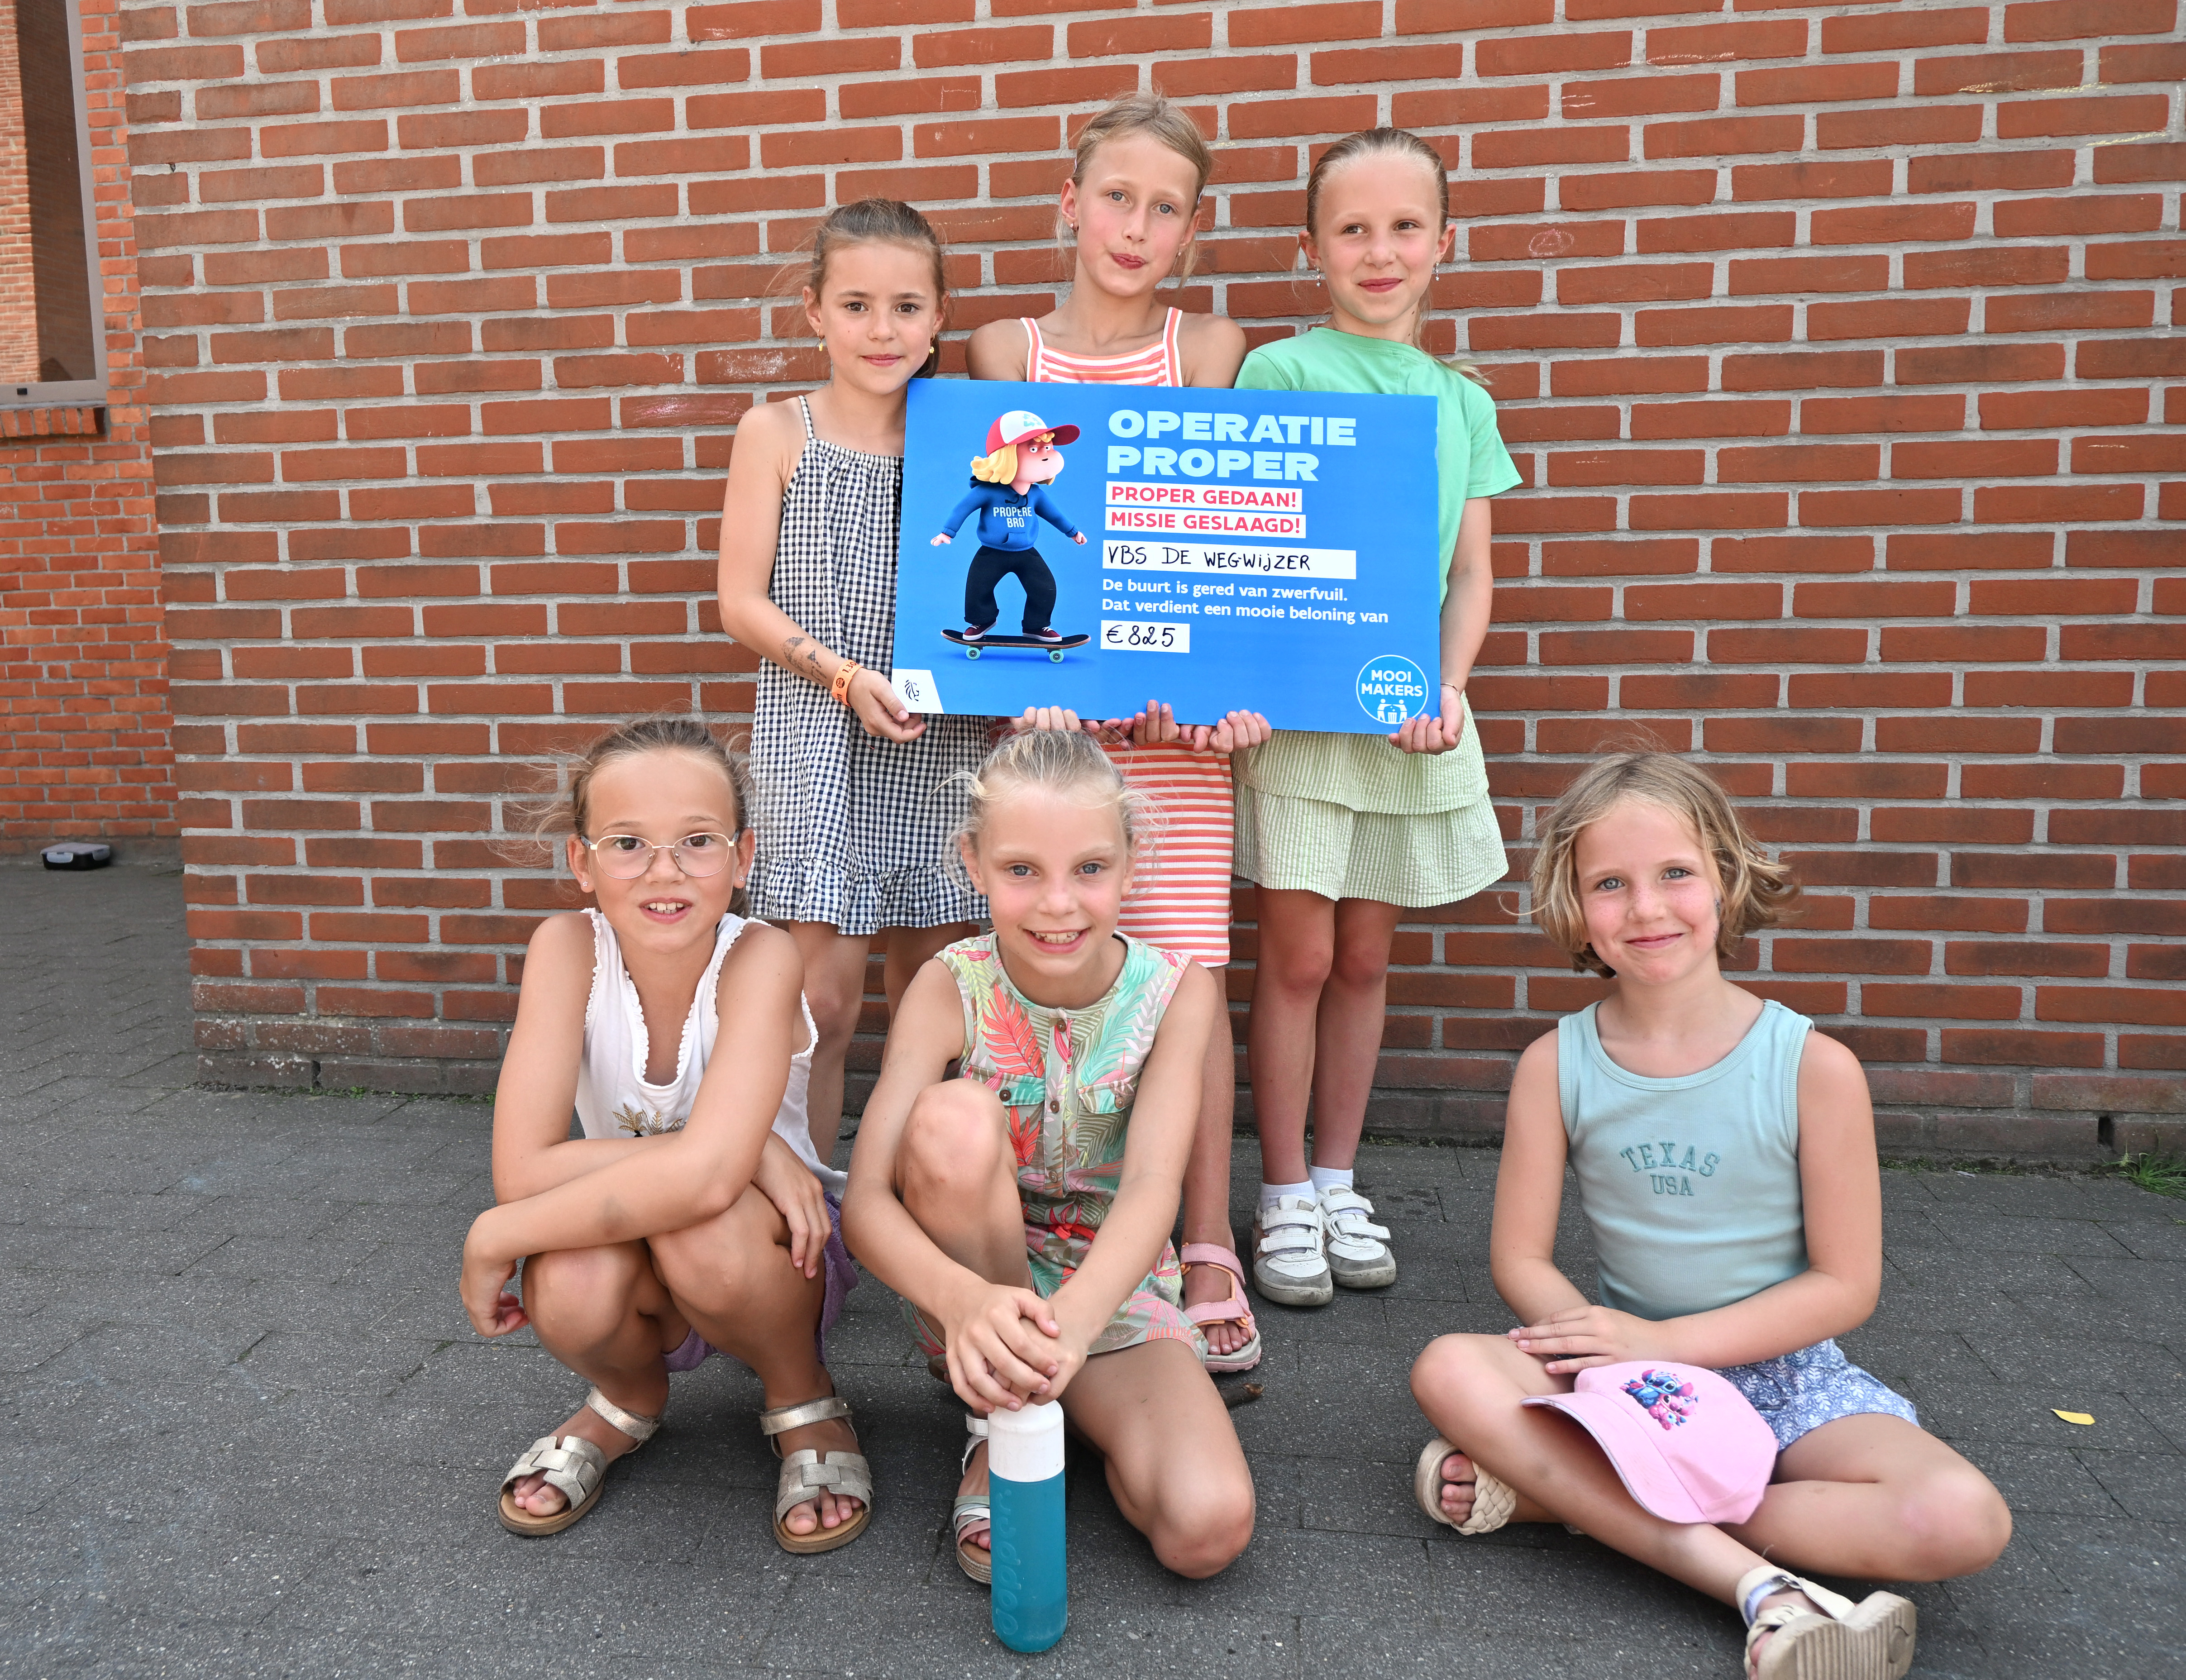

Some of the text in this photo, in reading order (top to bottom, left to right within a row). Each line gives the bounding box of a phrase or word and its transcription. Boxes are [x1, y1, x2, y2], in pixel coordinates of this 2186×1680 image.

[1108, 409, 1356, 446] OPERATIE
[1107, 445, 1319, 481] PROPER
[1112, 486, 1296, 507] PROPER GEDAAN!
[993, 507, 1032, 517] PROPERE
[1006, 517, 1025, 528] BRO
[1111, 512, 1300, 534] MISSIE GESLAAGD!
[1107, 545, 1147, 564] VBS
[1161, 547, 1191, 565] DE
[1103, 579, 1348, 601] De buurt is gered van zwerfvuil.
[1102, 598, 1388, 625] Dat verdient een mooie beloning van
[1371, 669, 1411, 682] MOOI
[1361, 683, 1423, 697] MAKERS
[1619, 1141, 1720, 1177] TEXAS
[1650, 1173, 1694, 1196] USA
